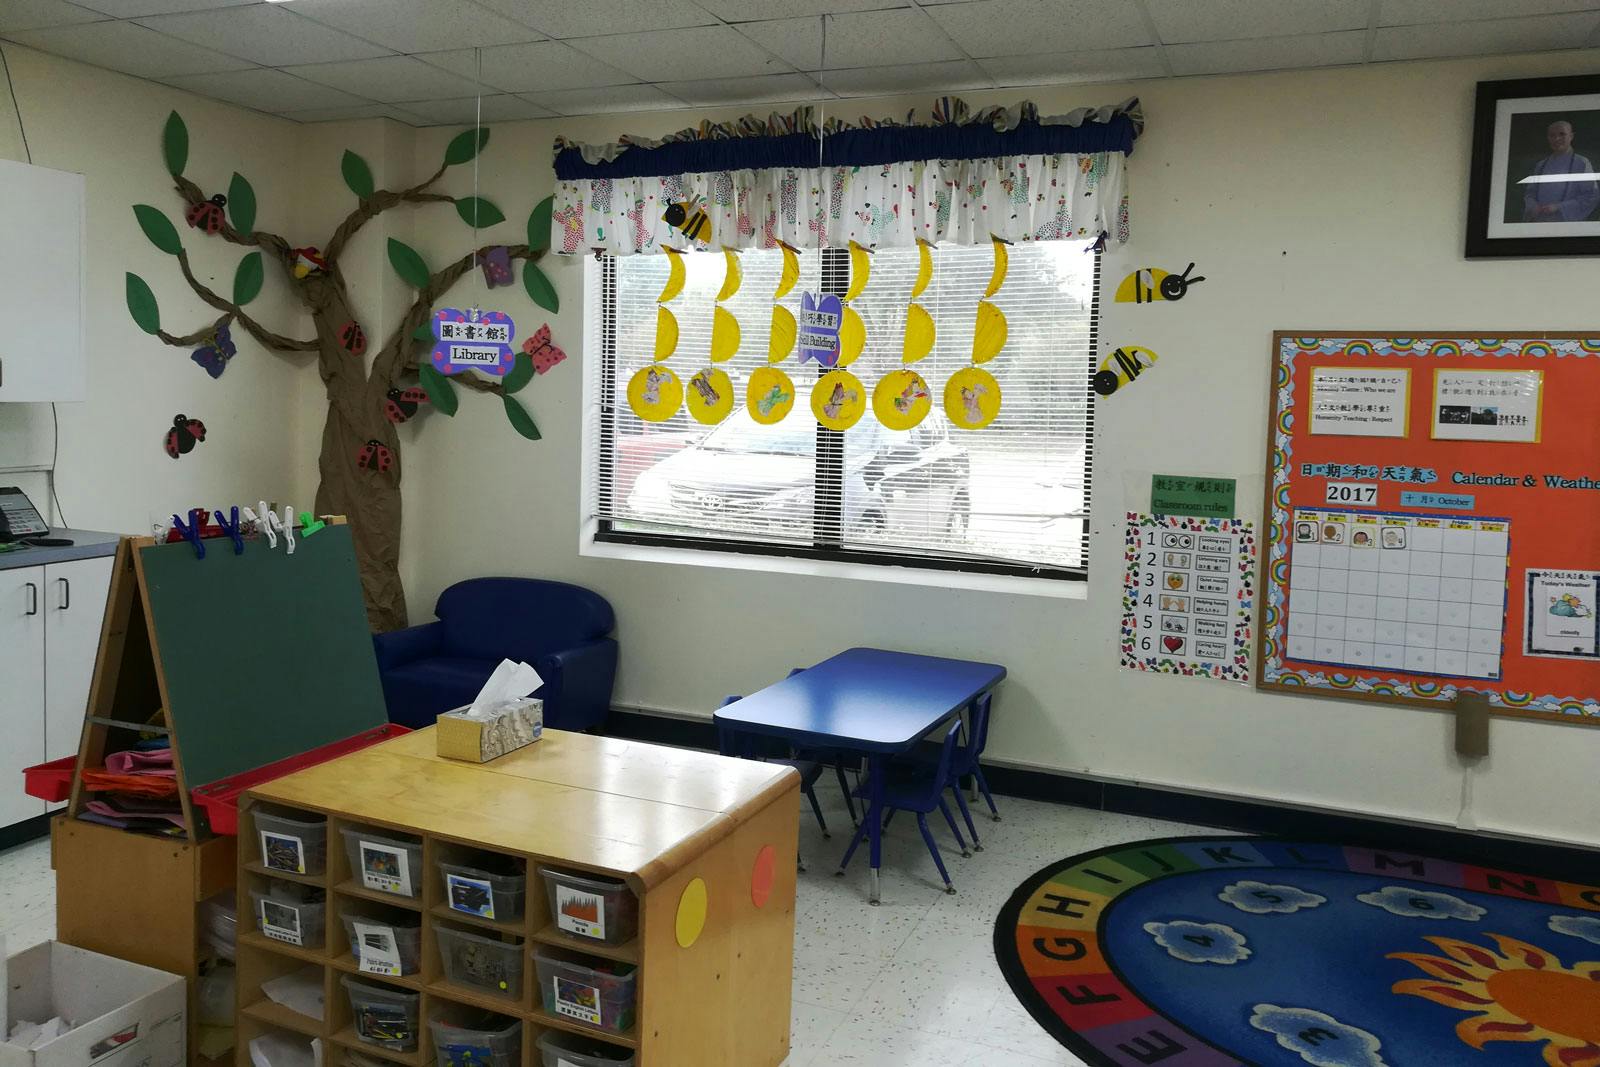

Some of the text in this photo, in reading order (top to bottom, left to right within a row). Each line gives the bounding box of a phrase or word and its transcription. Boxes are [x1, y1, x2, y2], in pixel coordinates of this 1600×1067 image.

[442, 325, 507, 341] 圖書館
[452, 348, 497, 363] Library
[1452, 471, 1520, 487] Calendar
[1522, 474, 1537, 488] &
[1327, 486, 1377, 502] 2017
[1438, 497, 1470, 506] October
[1153, 499, 1228, 512] Classroom rules
[1147, 531, 1156, 546] 1
[1335, 533, 1341, 542] 2
[1367, 538, 1373, 547] 3
[1147, 552, 1157, 566] 2
[1145, 573, 1154, 587] 3
[1143, 593, 1153, 608] 4
[1143, 615, 1153, 629] 5
[1141, 636, 1151, 651] 6
[1140, 851, 1175, 873] J
[1202, 846, 1254, 864] K
[1374, 853, 1425, 876] M
[1082, 868, 1122, 884] I
[1487, 874, 1541, 896] N
[1251, 891, 1284, 903] 5
[1037, 893, 1090, 919] H
[1183, 934, 1215, 948] 4
[1033, 937, 1087, 961] G
[1056, 984, 1121, 1006] F
[1298, 1026, 1339, 1046] 3
[1116, 1029, 1188, 1065] E
